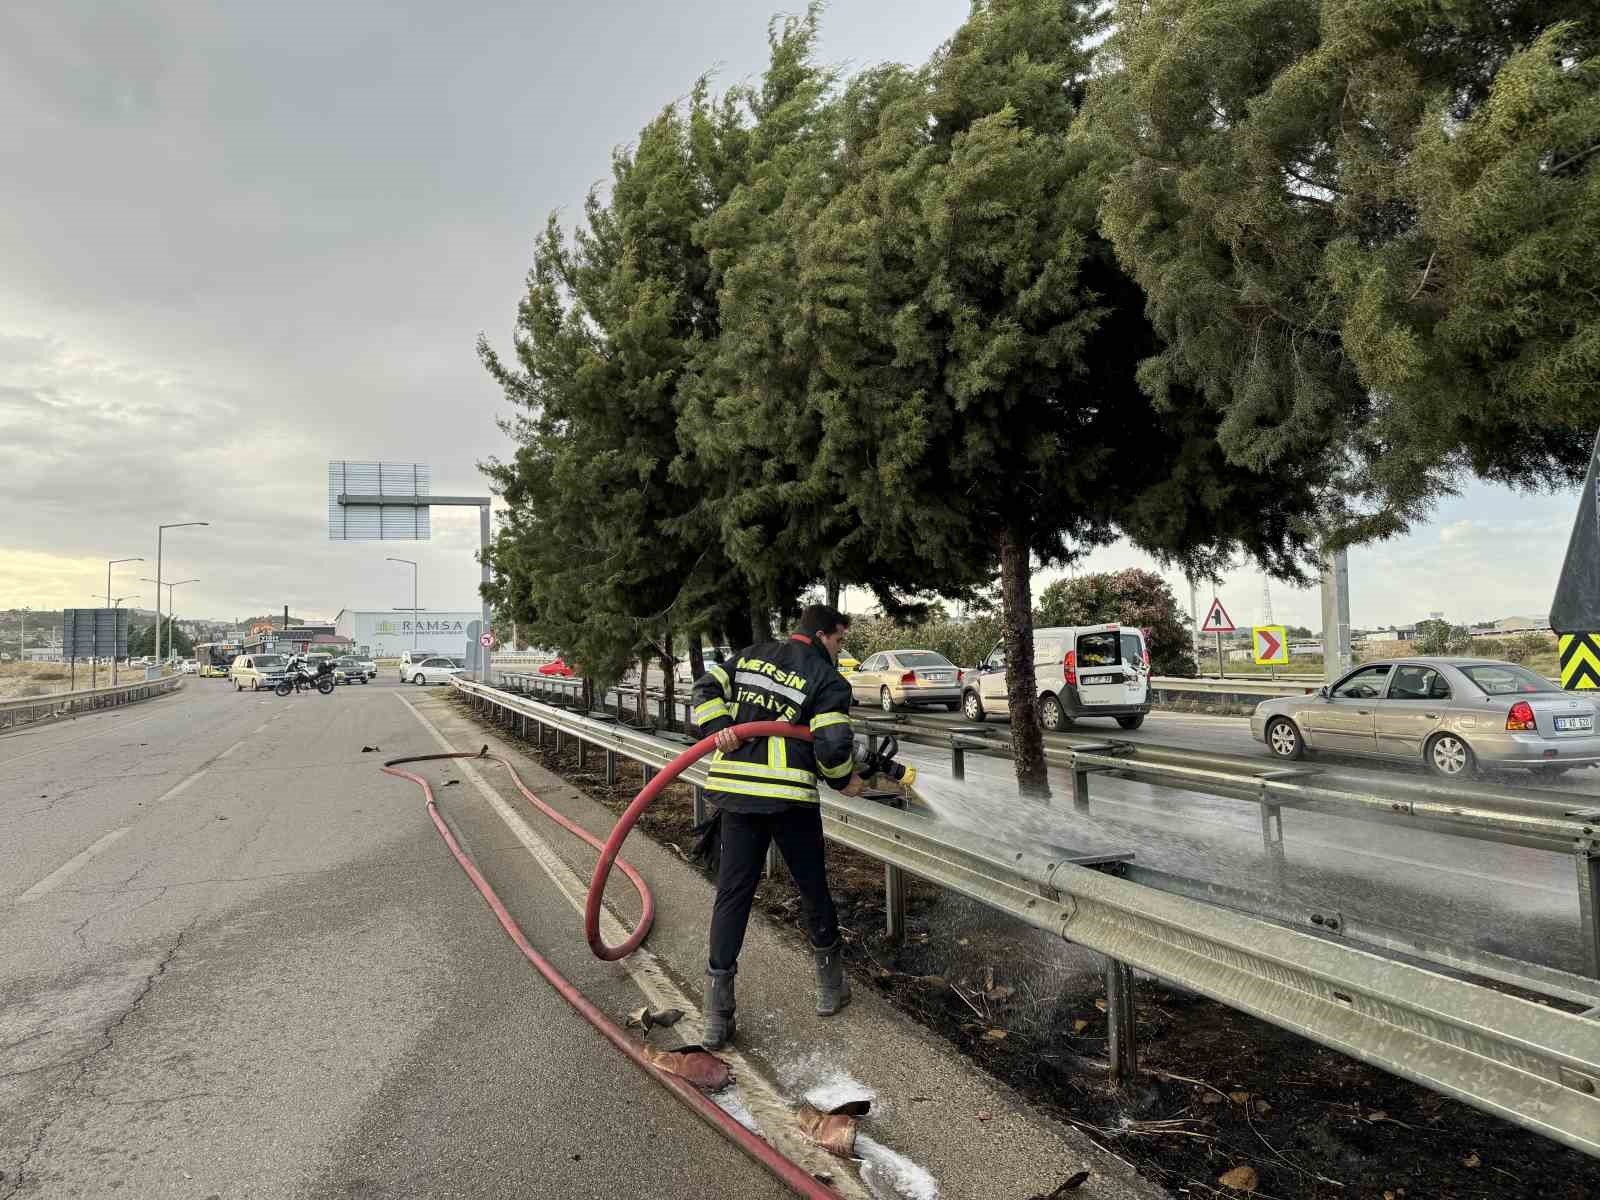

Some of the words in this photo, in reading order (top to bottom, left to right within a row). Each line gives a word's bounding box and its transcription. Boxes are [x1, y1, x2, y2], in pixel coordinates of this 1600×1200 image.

[402, 620, 463, 631] RAMSA
[736, 656, 807, 690] MERSİN
[736, 686, 798, 720] İTFAİYE
